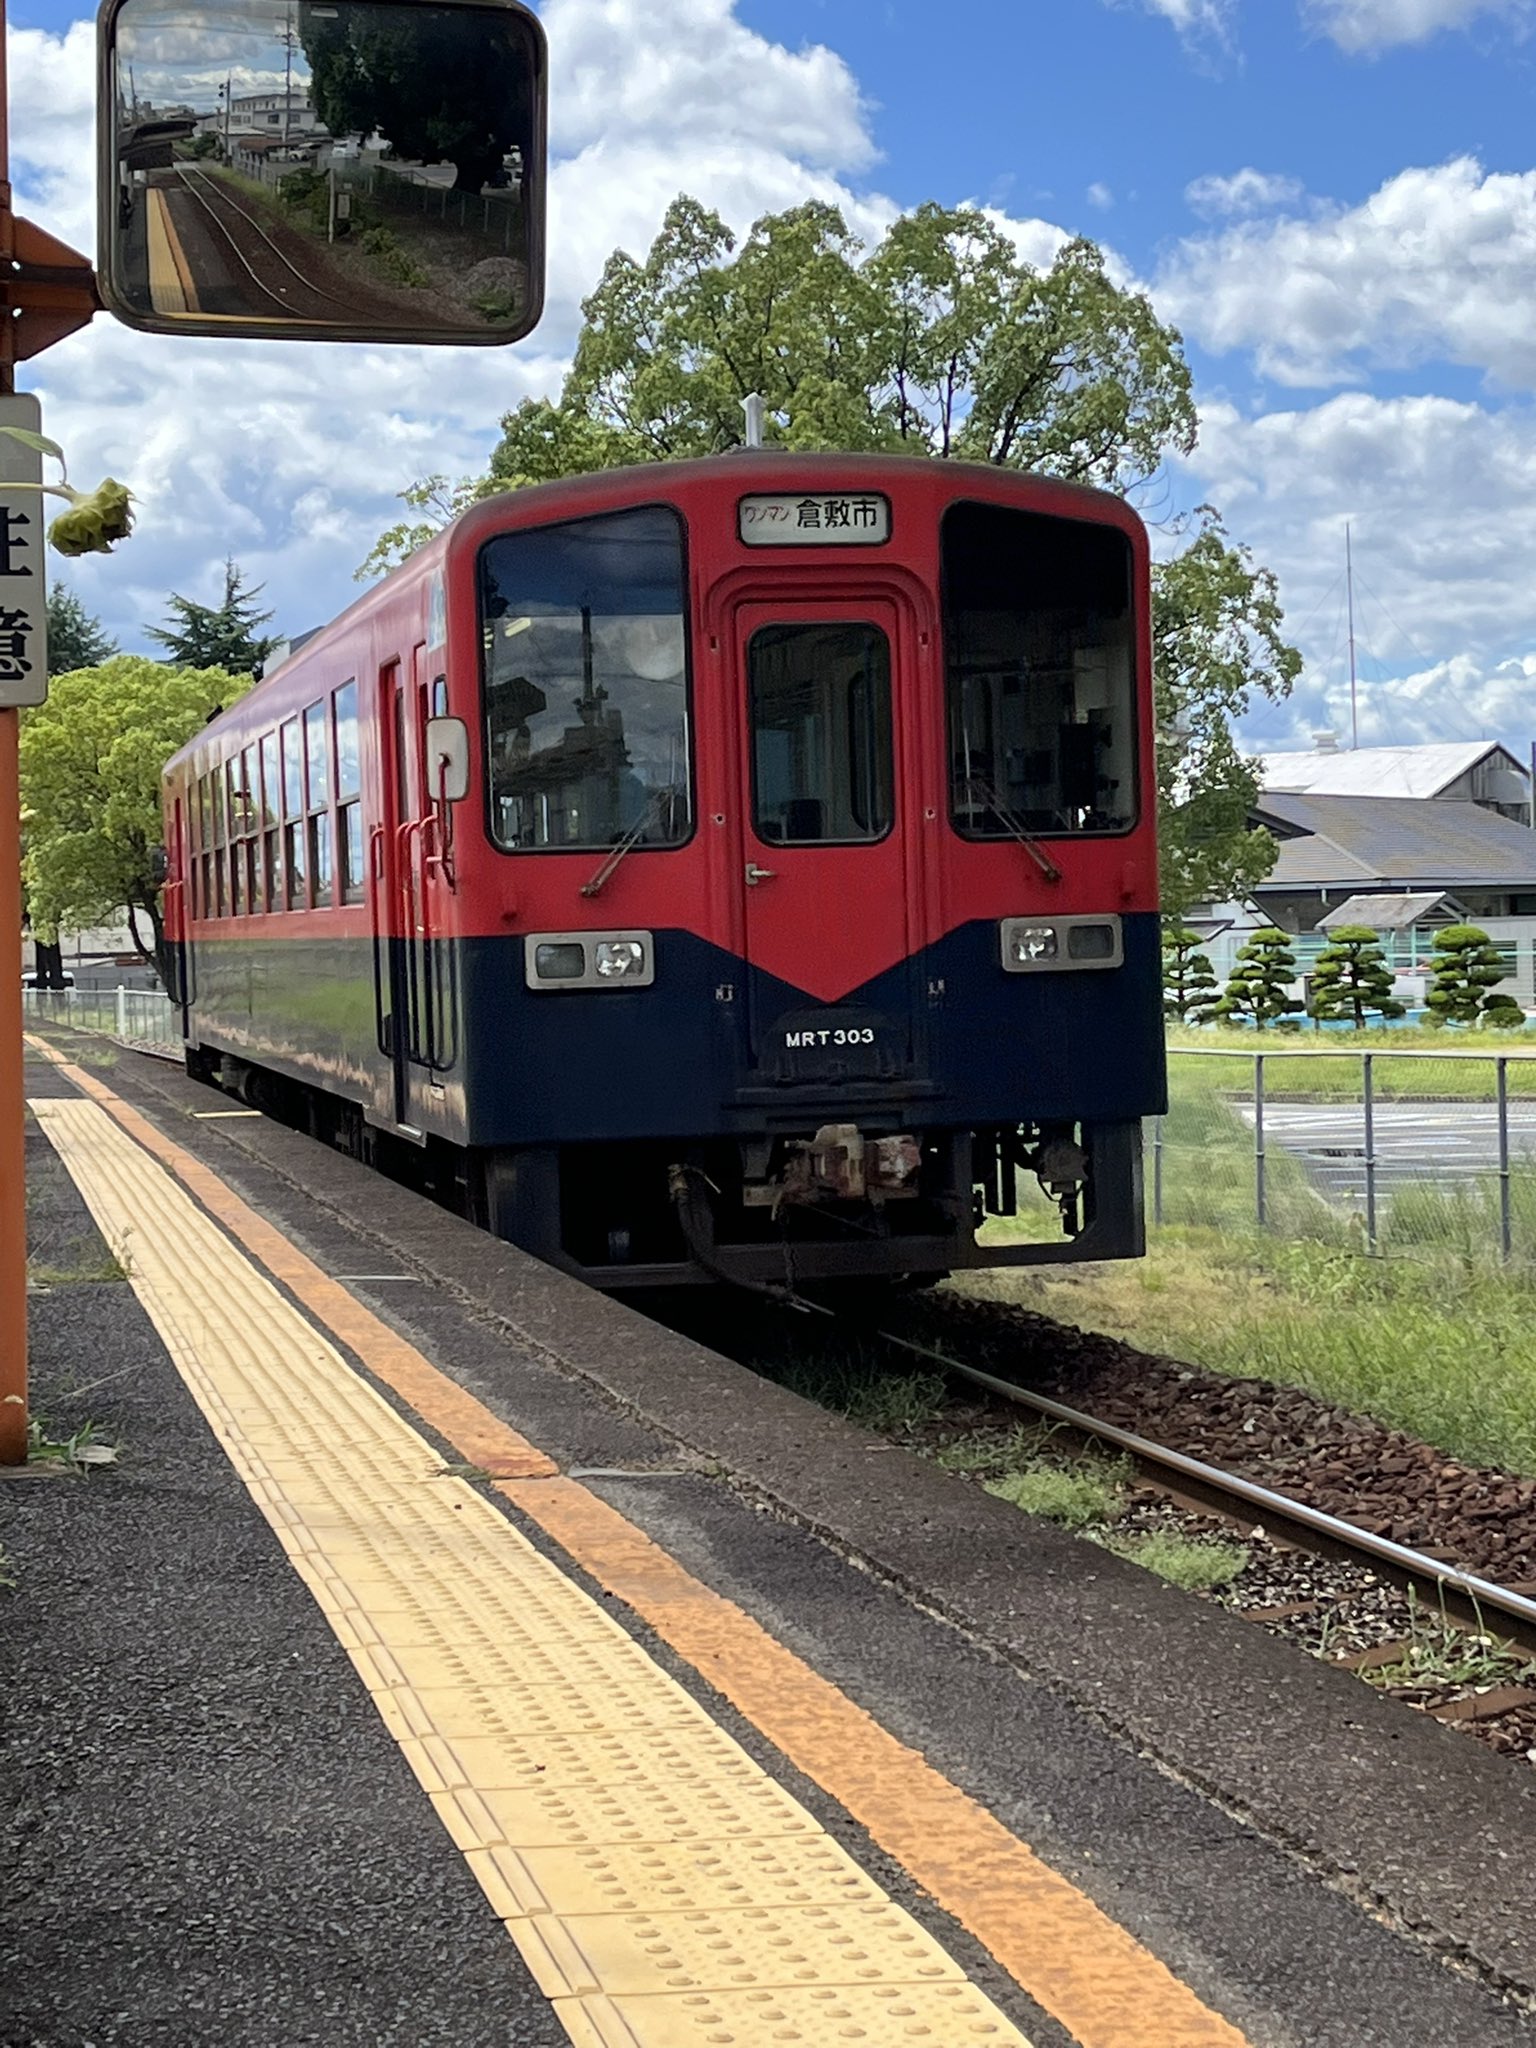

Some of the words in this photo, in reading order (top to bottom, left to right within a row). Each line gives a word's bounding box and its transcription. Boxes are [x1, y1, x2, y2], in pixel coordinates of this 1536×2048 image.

[744, 506, 790, 523] ワンマン
[796, 499, 878, 528] 倉敷市
